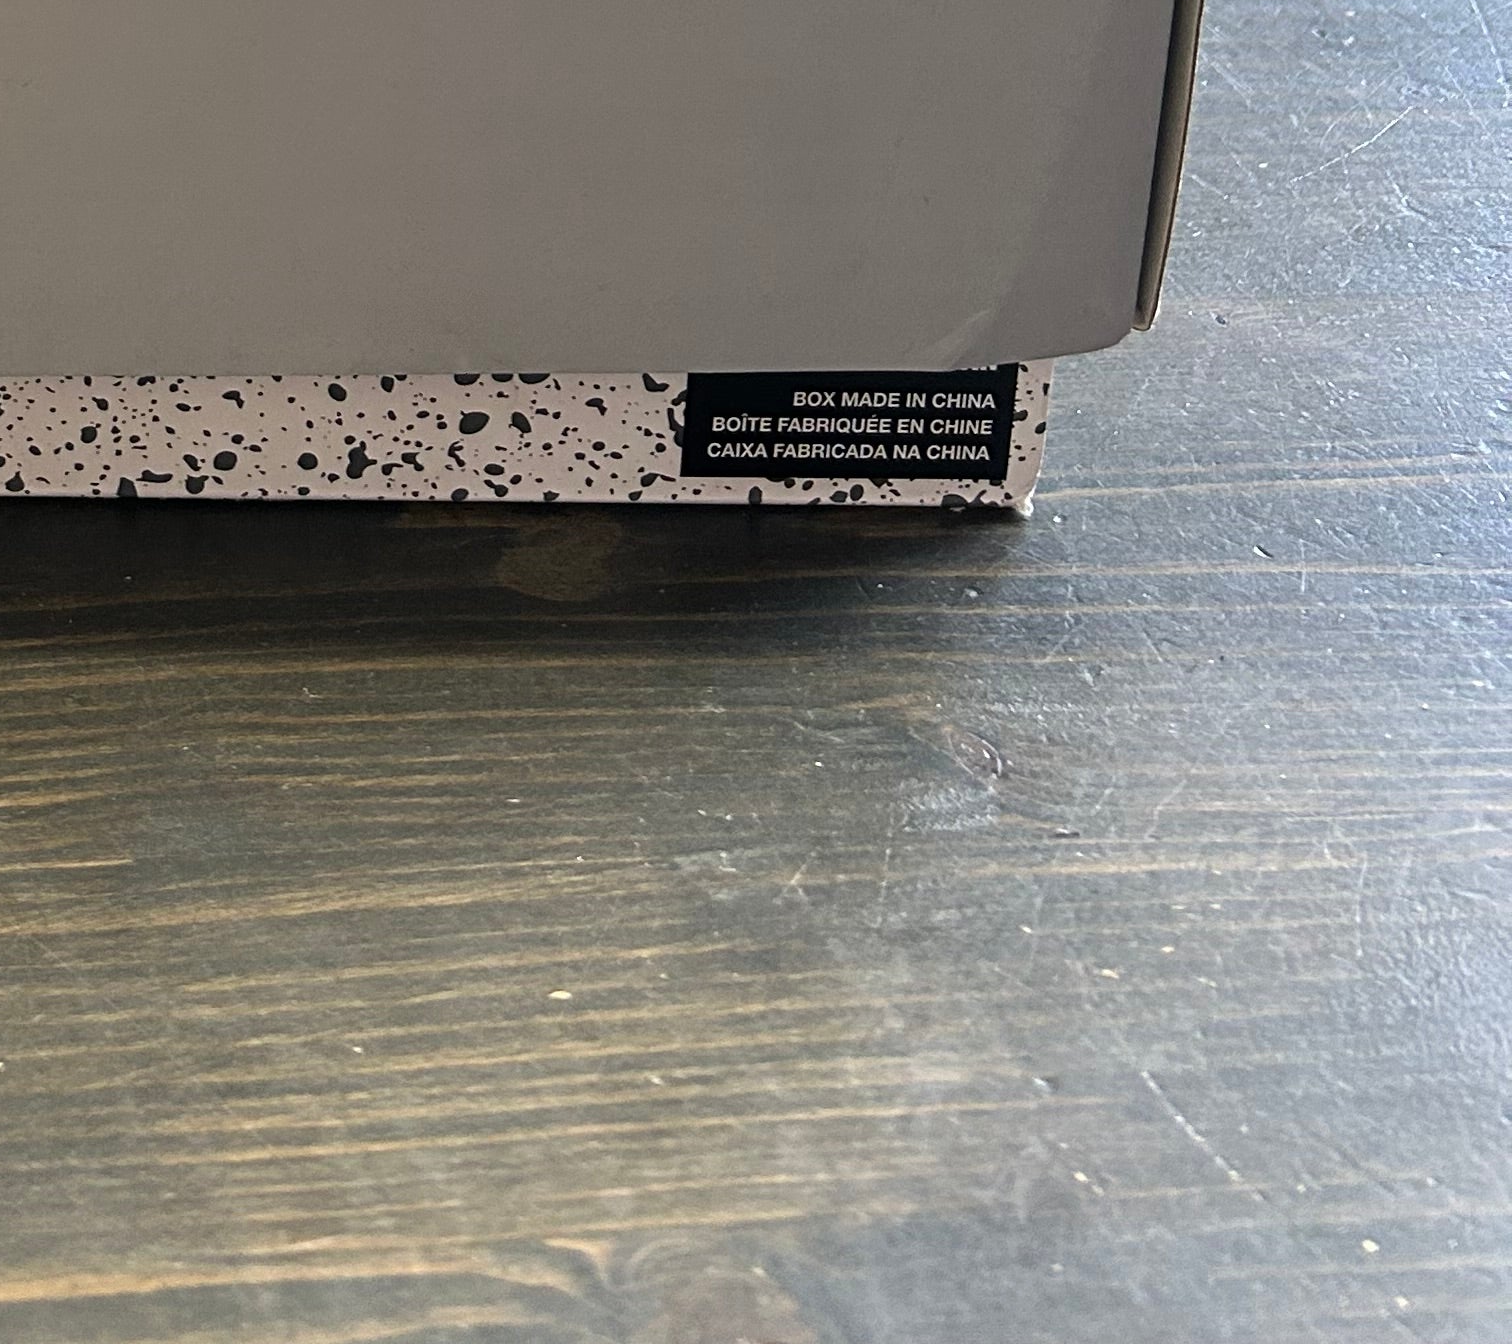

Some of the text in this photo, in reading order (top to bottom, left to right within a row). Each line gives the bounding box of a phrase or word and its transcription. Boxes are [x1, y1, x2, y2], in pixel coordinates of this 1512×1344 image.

[793, 391, 996, 409] BOX MADE IN CHINA
[712, 413, 993, 435] BOÎTE FABRIQUÉE EN CHINE
[707, 442, 990, 461] CAIXA FABRICADA NA CHINA
